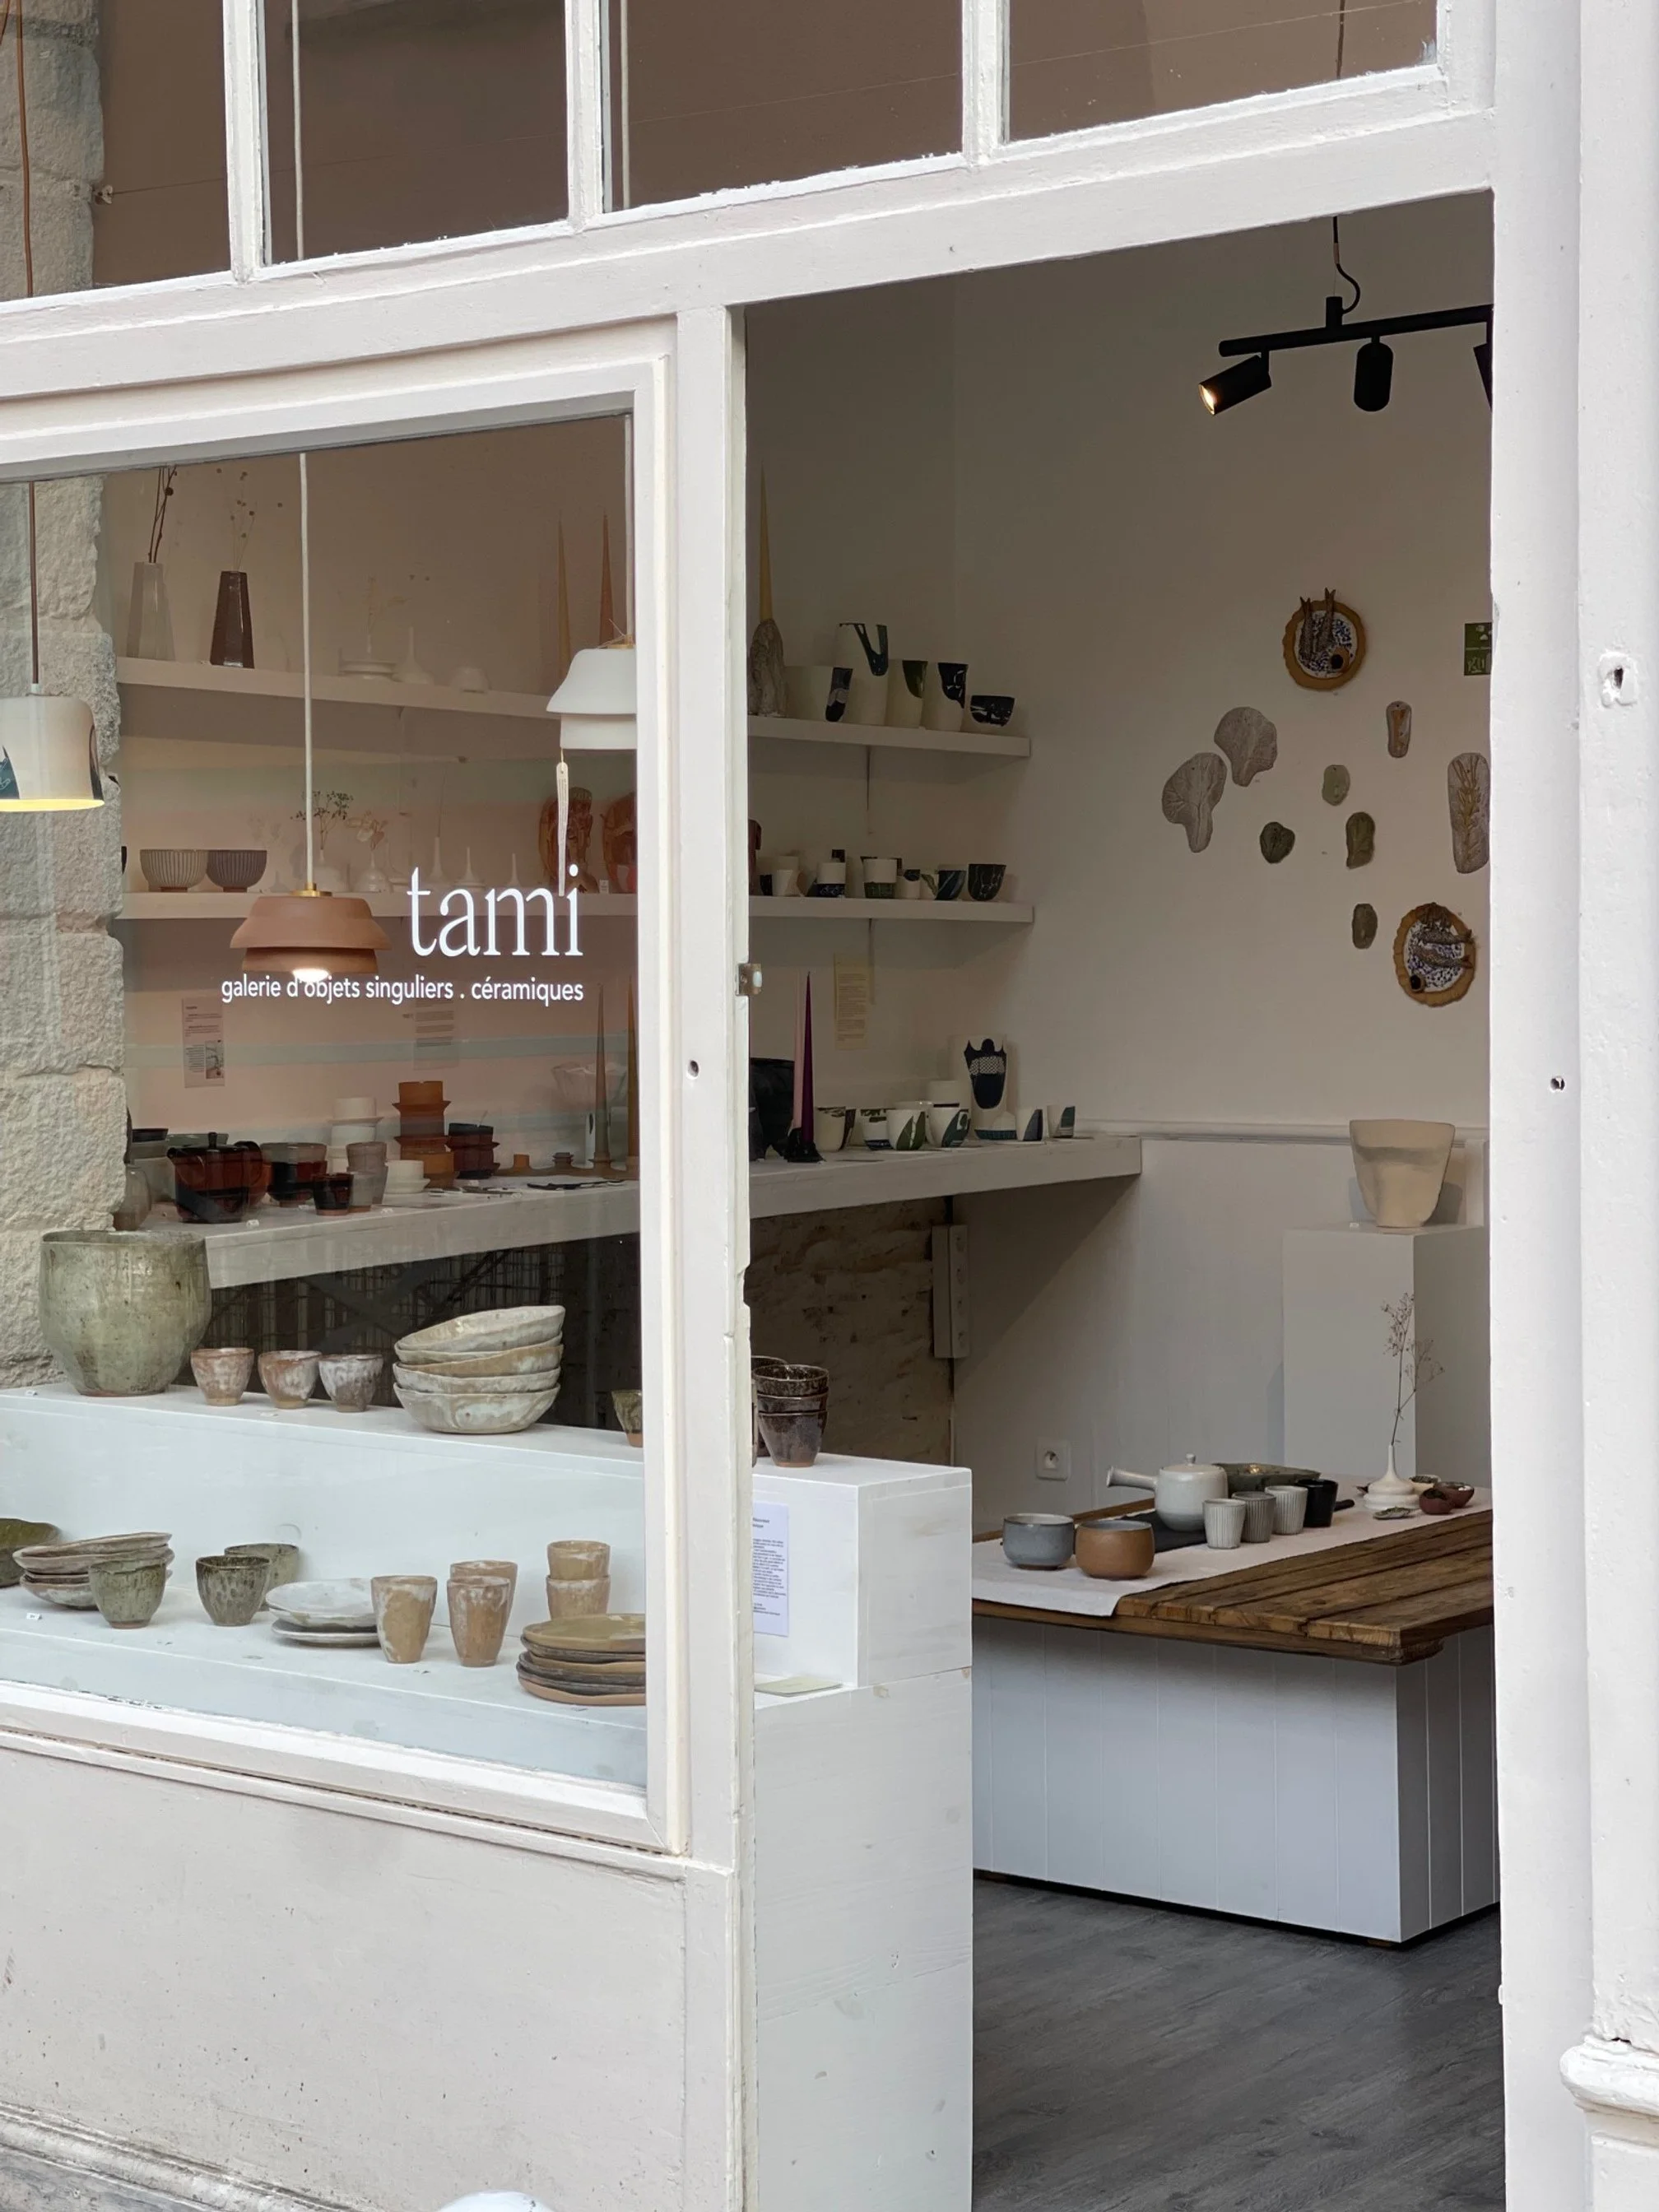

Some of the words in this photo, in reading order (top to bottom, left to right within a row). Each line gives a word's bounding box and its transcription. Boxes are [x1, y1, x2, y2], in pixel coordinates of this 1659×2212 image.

[407, 863, 583, 957] tami
[221, 974, 281, 1003] galerie
[286, 974, 360, 1005] d'objets
[365, 974, 454, 1006] singuliers
[471, 977, 584, 1007] céramiques
